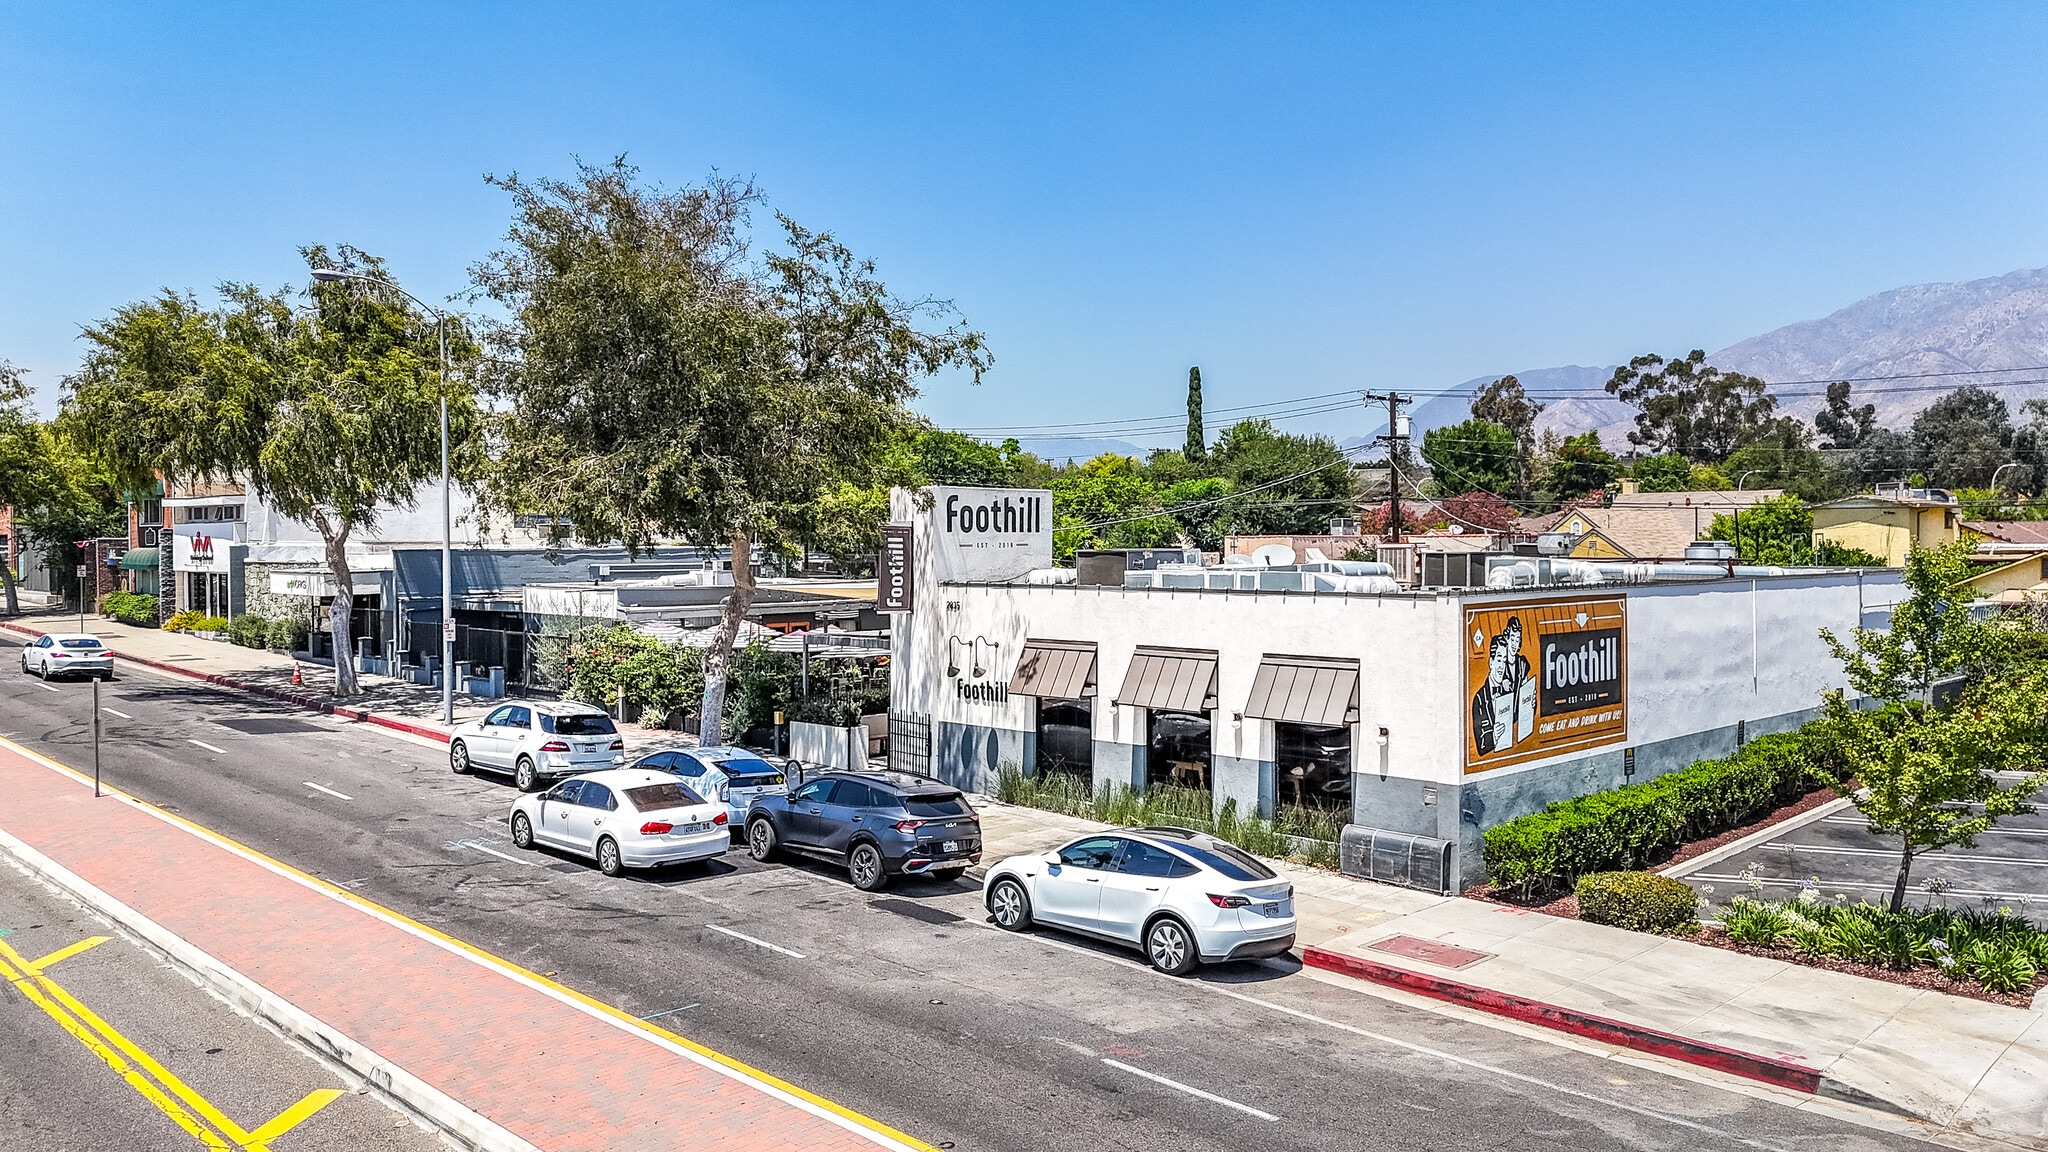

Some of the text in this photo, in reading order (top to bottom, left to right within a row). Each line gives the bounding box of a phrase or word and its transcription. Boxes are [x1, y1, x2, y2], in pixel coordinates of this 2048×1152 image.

[946, 494, 1040, 533] Foothill
[886, 537, 904, 607] Foothill
[1545, 637, 1617, 690] Foothill
[957, 678, 1008, 703] Foothill
[1539, 710, 1623, 734] COME EAT AND DRINK WITH US!
